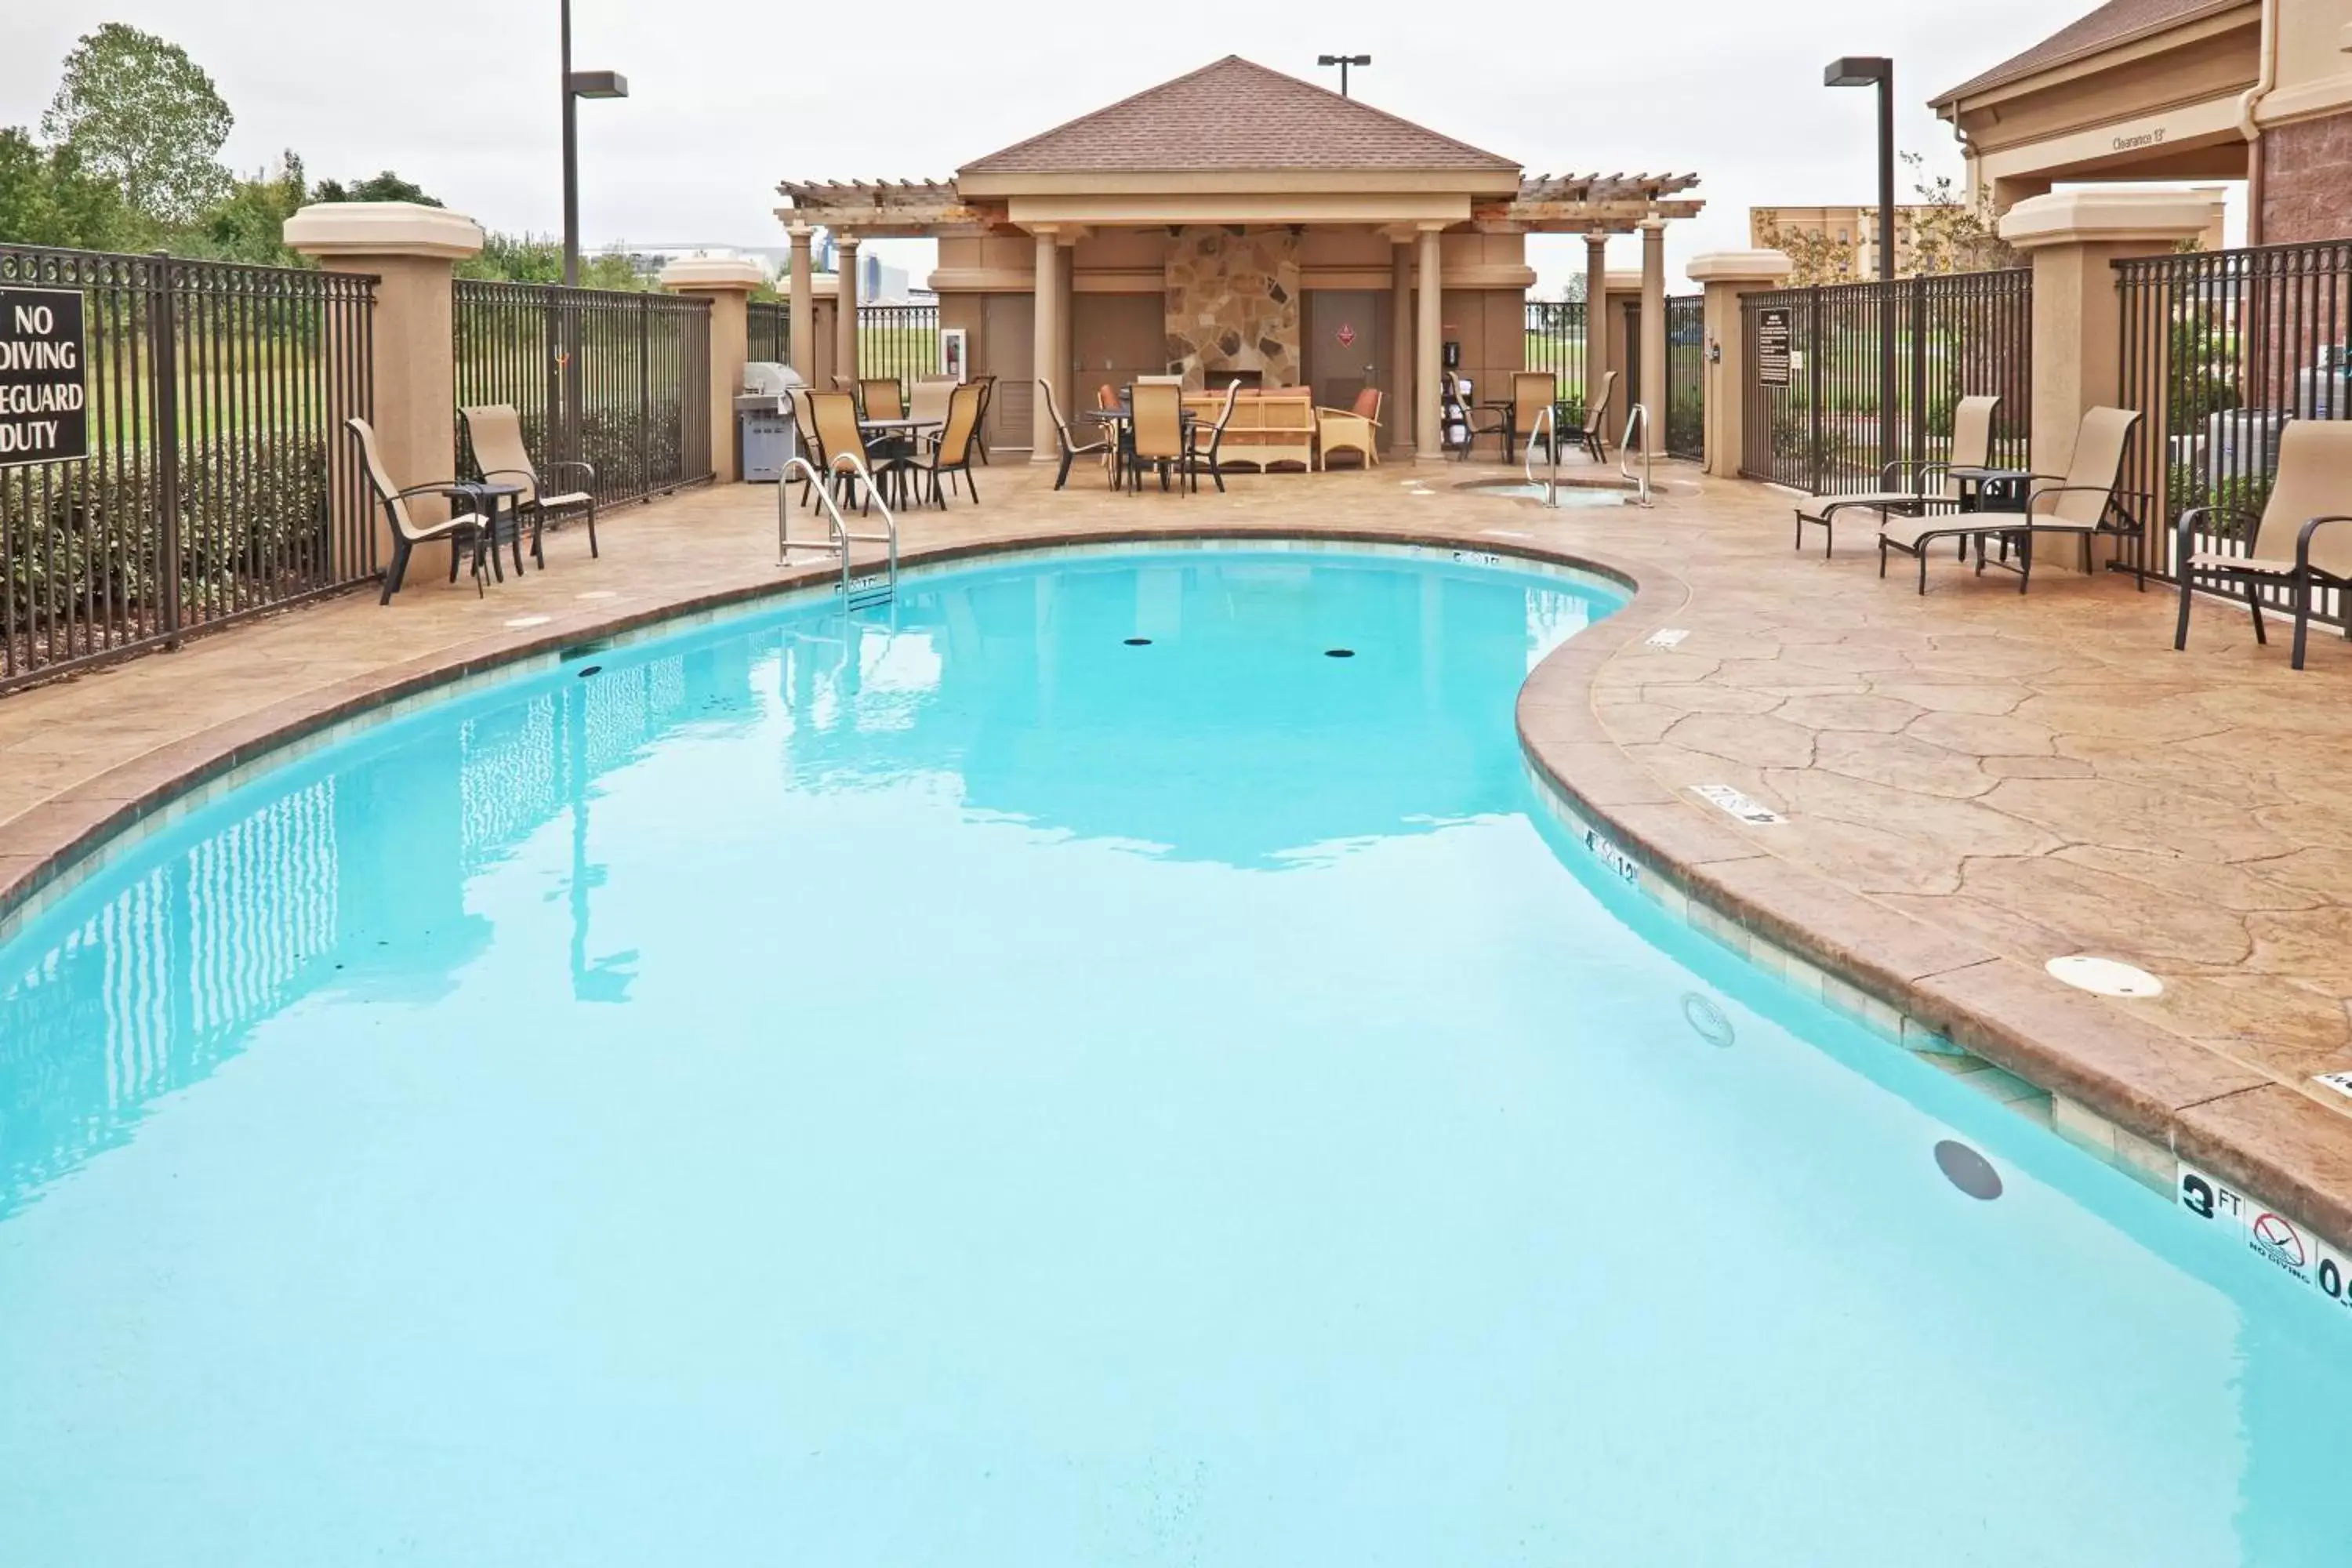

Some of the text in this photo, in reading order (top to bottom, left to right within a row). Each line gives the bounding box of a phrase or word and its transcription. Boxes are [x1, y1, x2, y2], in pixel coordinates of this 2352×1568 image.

[2113, 134, 2152, 151] Clearance
[15, 305, 53, 335] NO
[0, 420, 58, 452] DUTY
[2183, 1174, 2241, 1219] 3 FT
